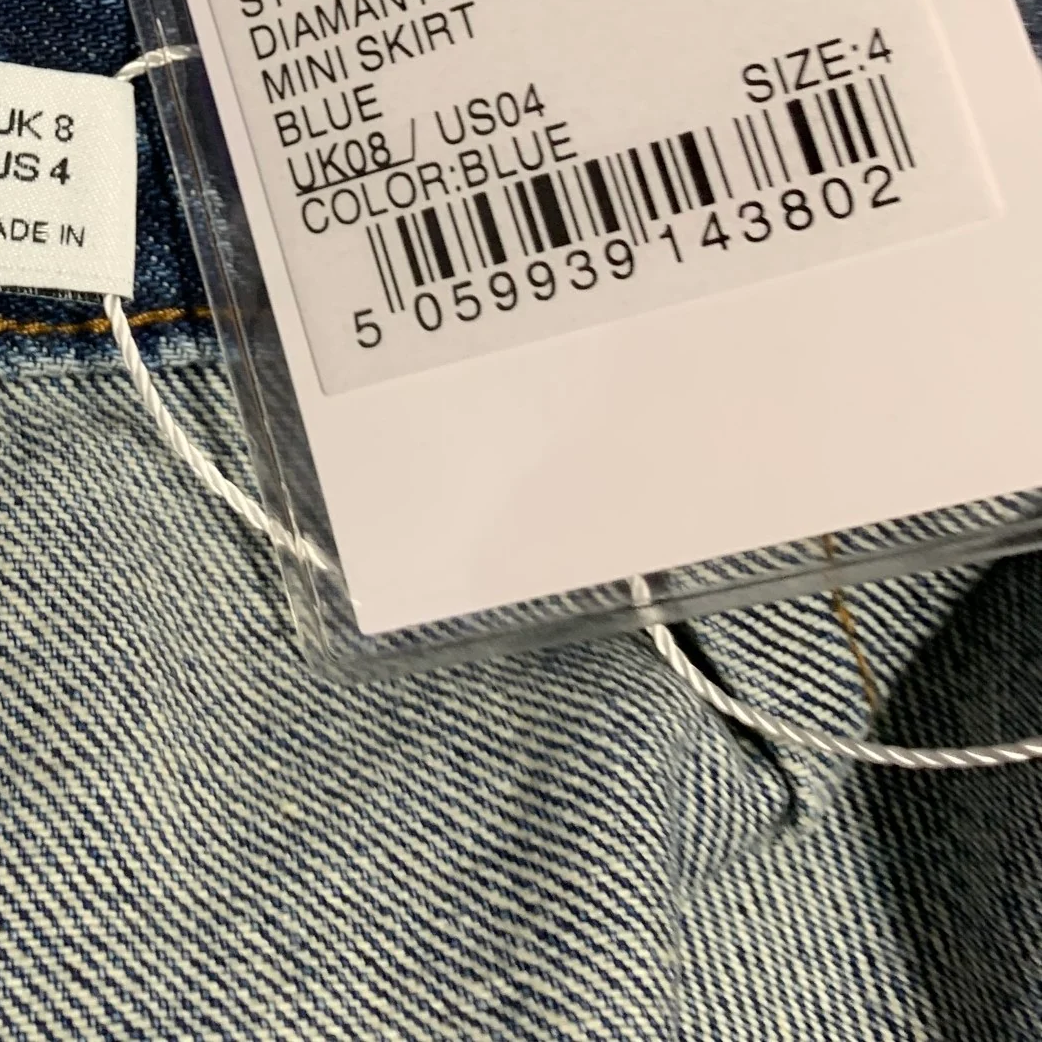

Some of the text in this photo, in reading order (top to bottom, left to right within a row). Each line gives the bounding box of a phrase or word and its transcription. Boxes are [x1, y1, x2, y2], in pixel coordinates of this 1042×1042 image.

[261, 0, 476, 105] MINI SKIRT
[740, 27, 893, 104] SIZE:4
[54, 113, 75, 143] 8
[273, 82, 383, 148] BLUE
[286, 131, 392, 195] UK08
[434, 82, 546, 146] US04
[49, 156, 71, 186] 4
[300, 121, 579, 235] COLOR:BLUE
[59, 225, 86, 248] IN
